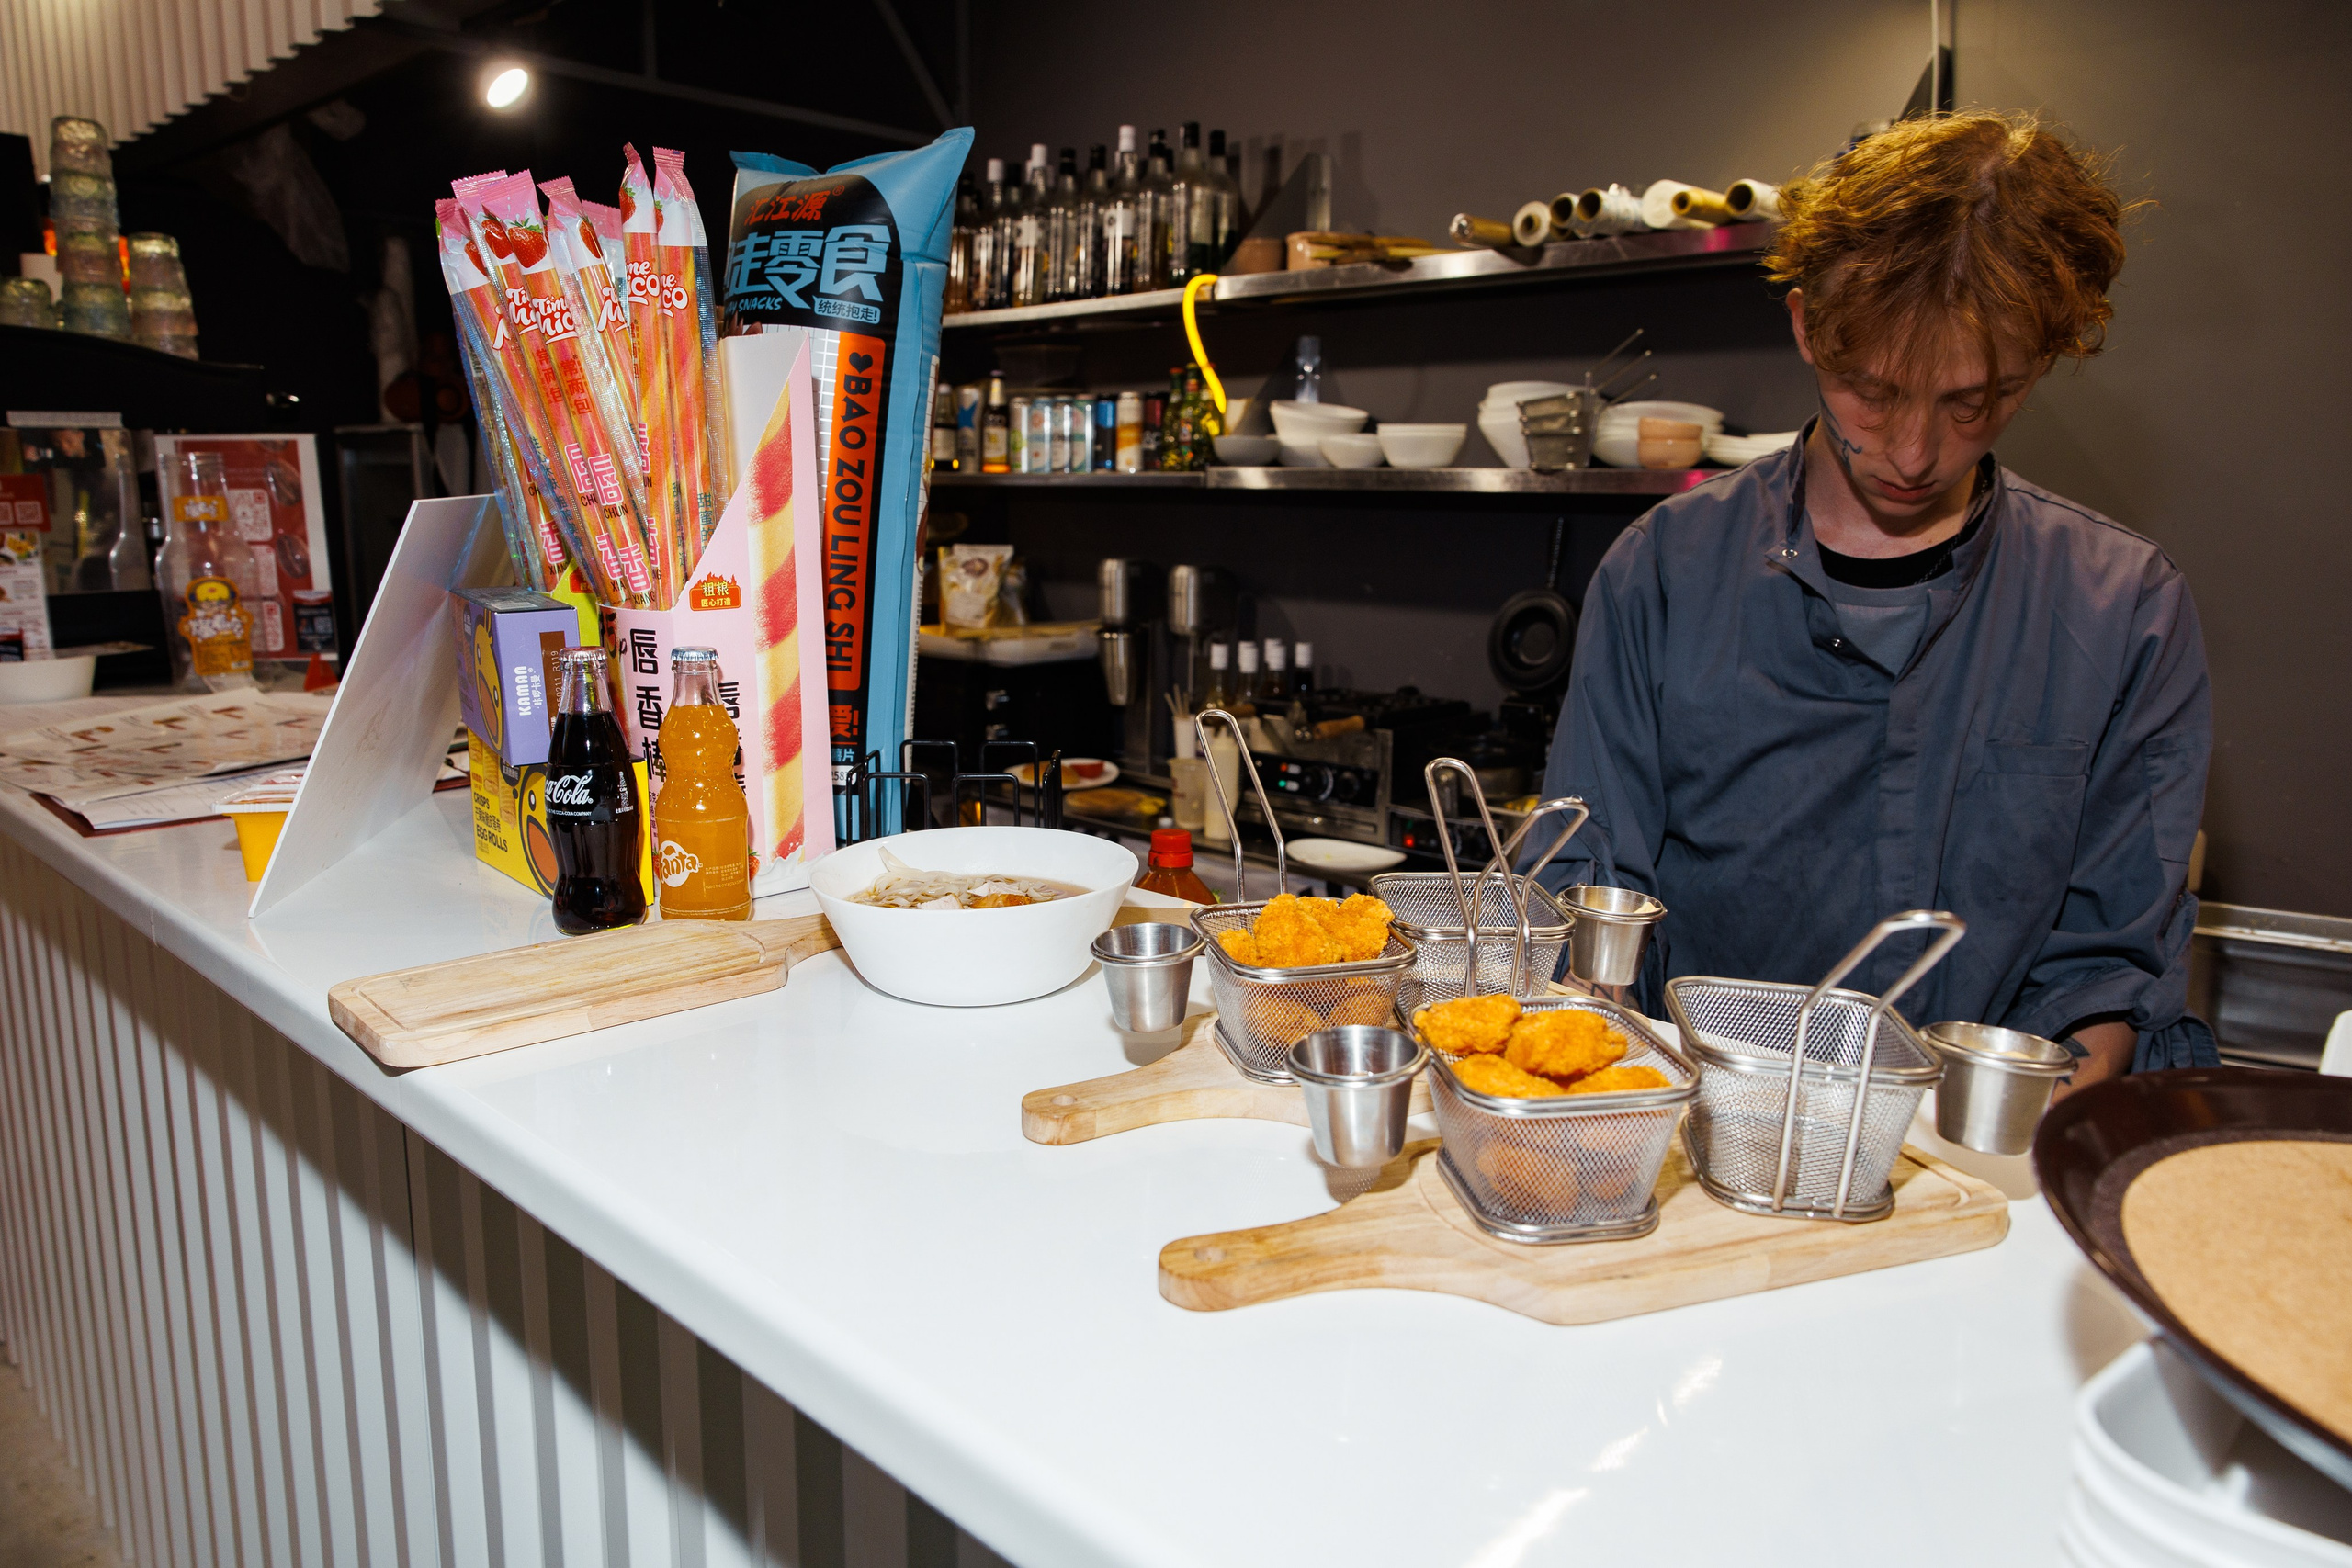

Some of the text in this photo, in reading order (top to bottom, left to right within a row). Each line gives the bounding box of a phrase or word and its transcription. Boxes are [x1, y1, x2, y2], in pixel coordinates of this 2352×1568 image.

[738, 296, 783, 312] SNACKS
[818, 300, 878, 321] 统统抱走!
[604, 505, 629, 519] CHUN
[826, 375, 873, 673] BAO ZOU LING SHI
[617, 543, 652, 593] 香
[703, 581, 729, 597] 粗粮
[476, 824, 488, 841] EGG
[488, 830, 508, 853] ROLLS
